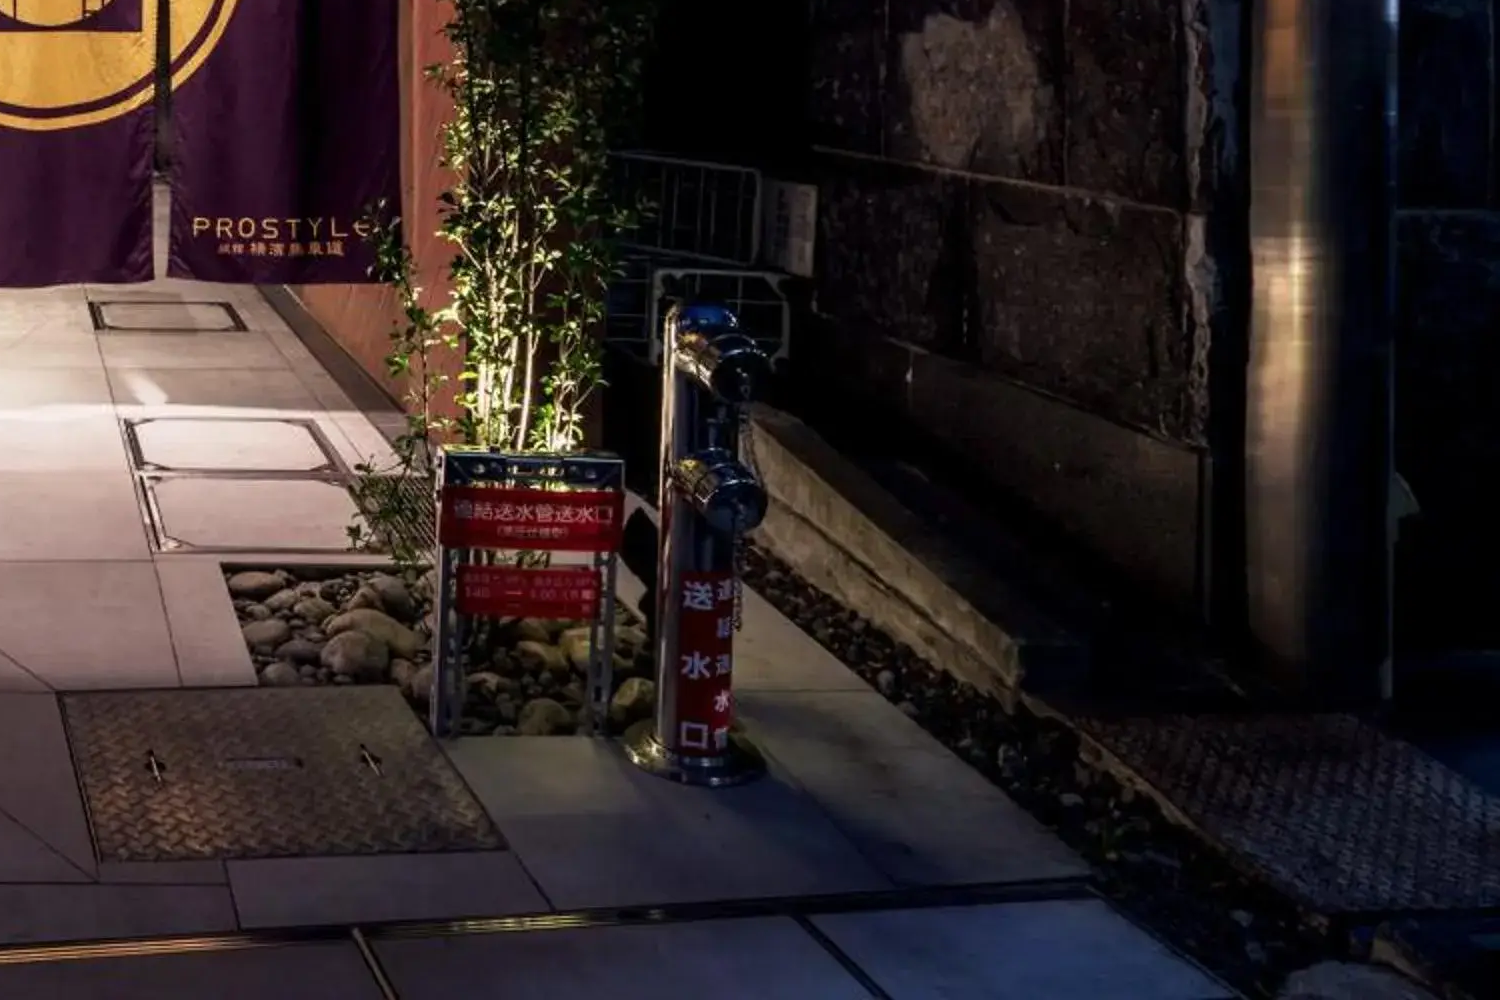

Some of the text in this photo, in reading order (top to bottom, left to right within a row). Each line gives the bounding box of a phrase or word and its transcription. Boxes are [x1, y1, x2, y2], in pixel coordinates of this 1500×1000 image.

[192, 217, 370, 239] PROSTYLE
[680, 579, 715, 749] 送水口
